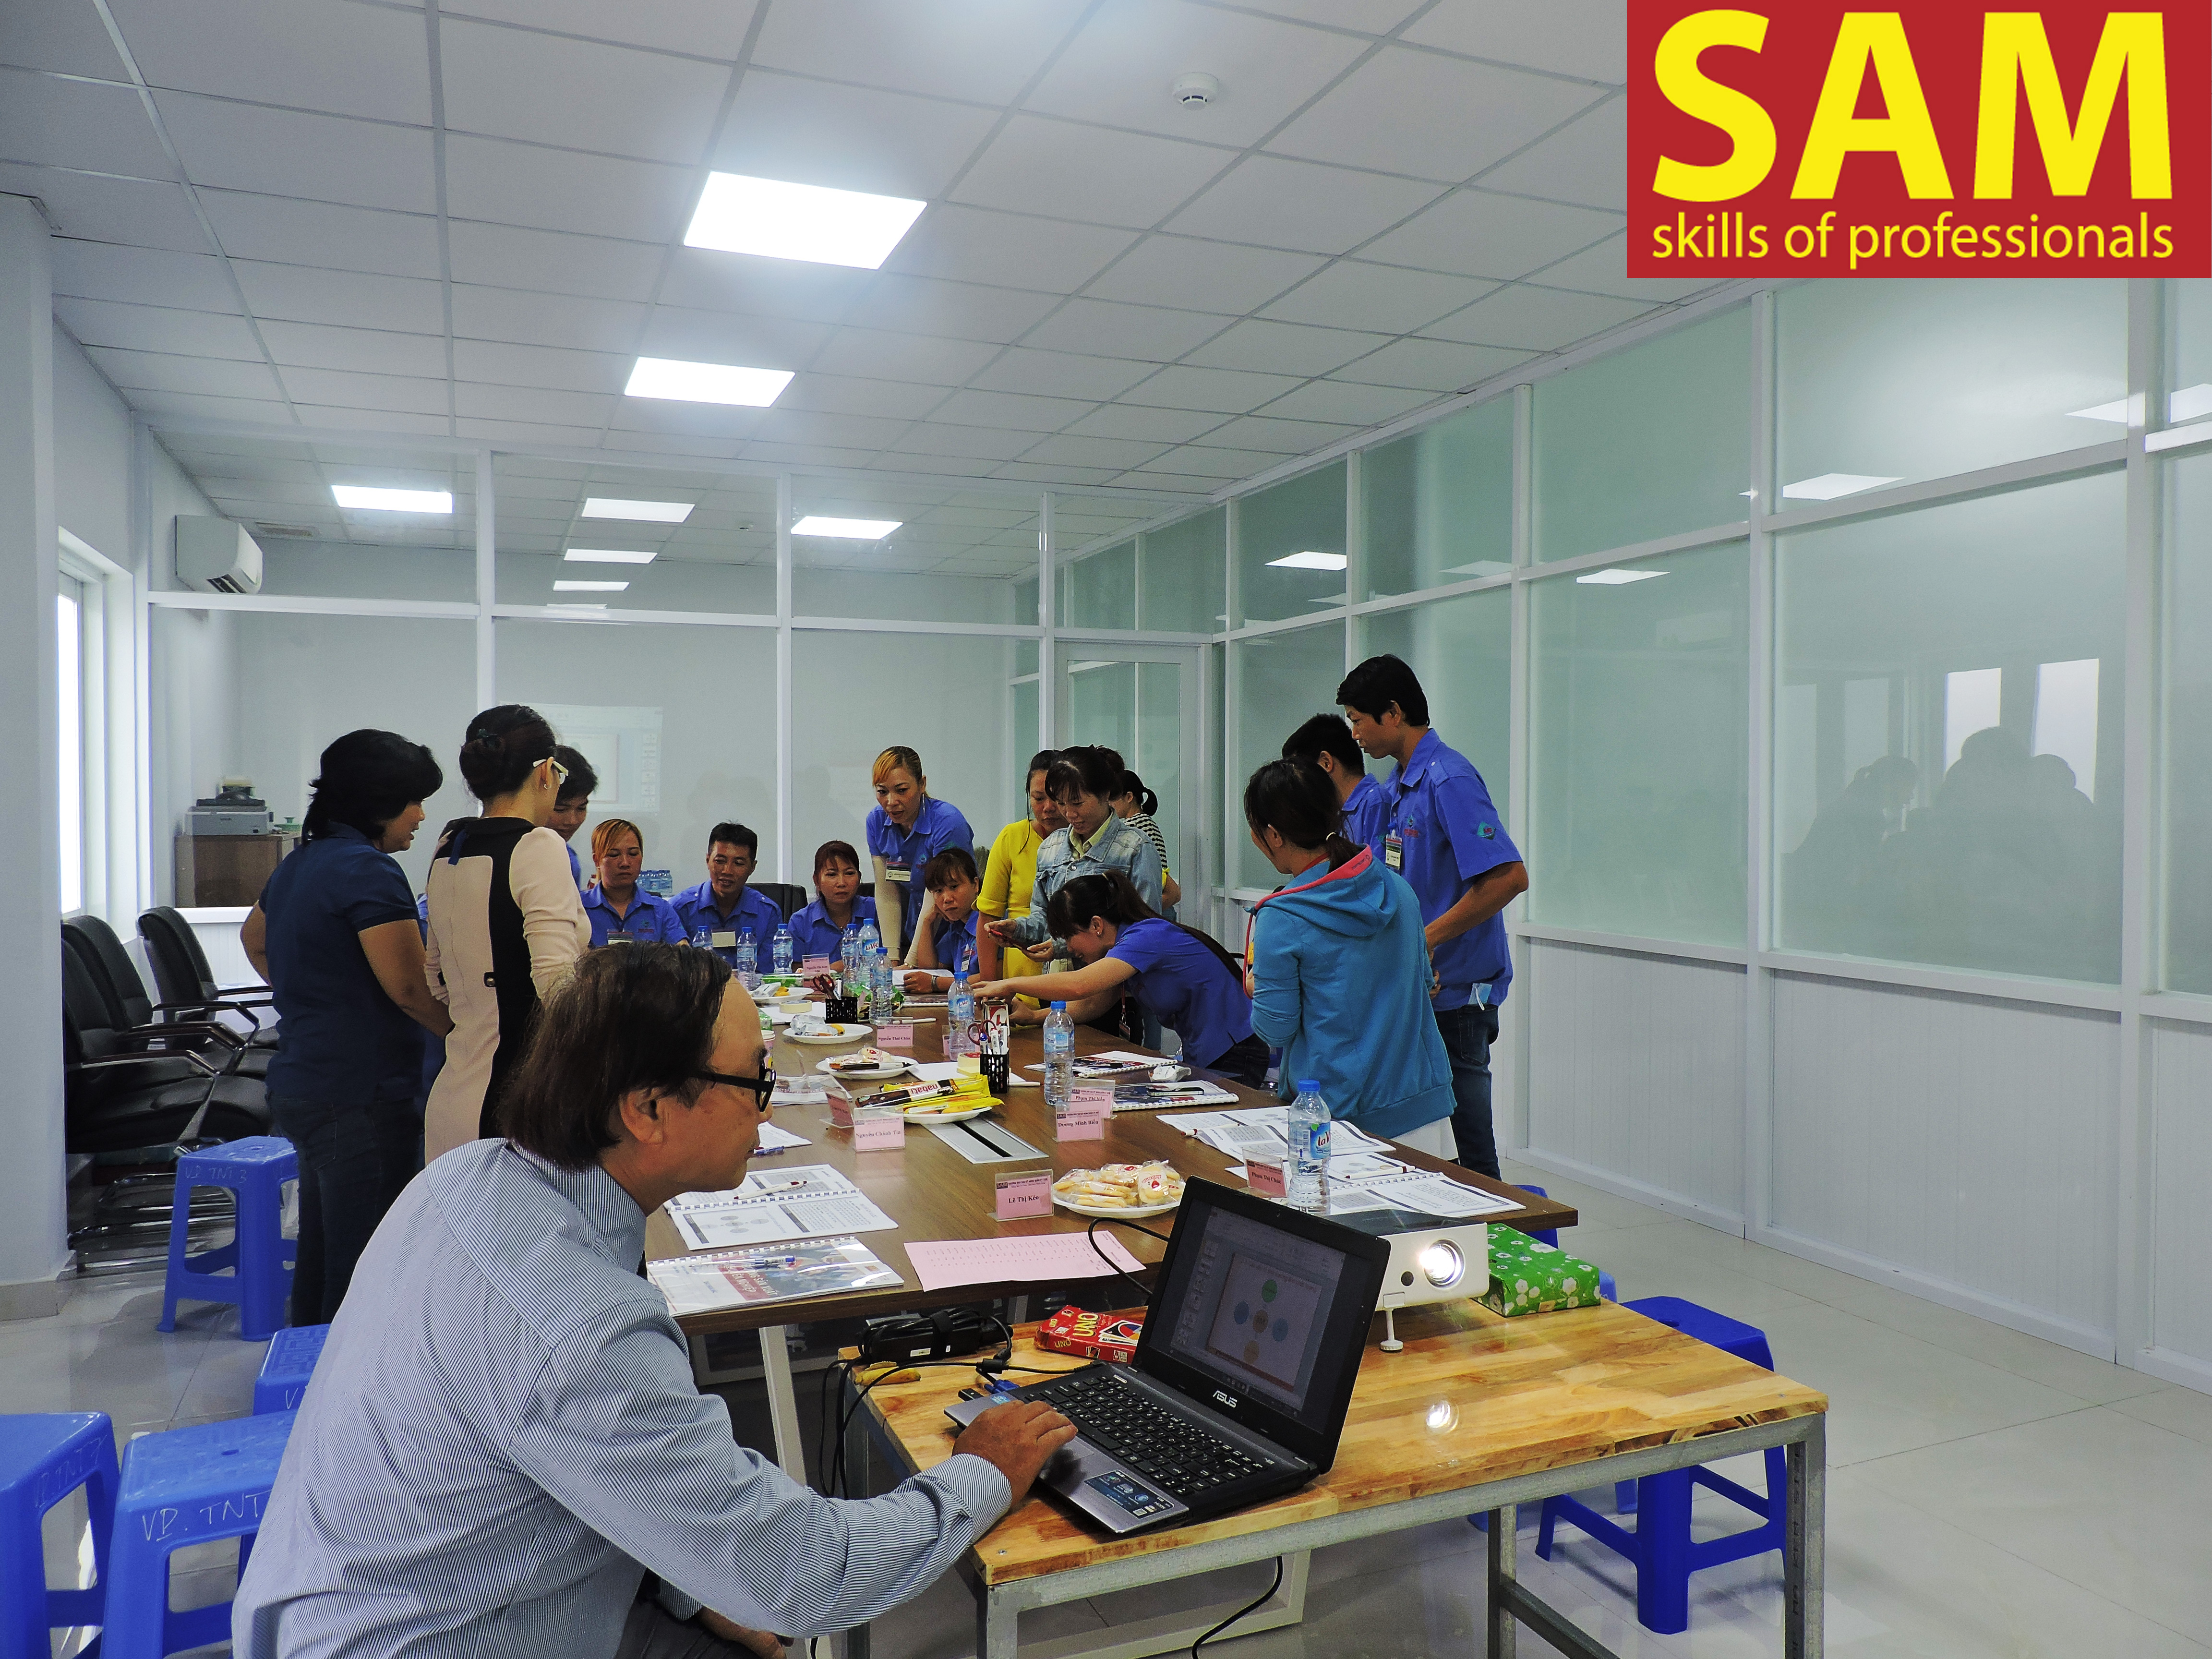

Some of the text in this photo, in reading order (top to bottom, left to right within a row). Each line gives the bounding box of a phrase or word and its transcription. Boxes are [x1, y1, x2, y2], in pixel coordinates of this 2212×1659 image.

[1072, 1312, 1099, 1336] UNO
[1054, 1339, 1071, 1348] UNO
[1213, 1390, 1238, 1408] ASUS
[199, 1489, 273, 1525] TNT
